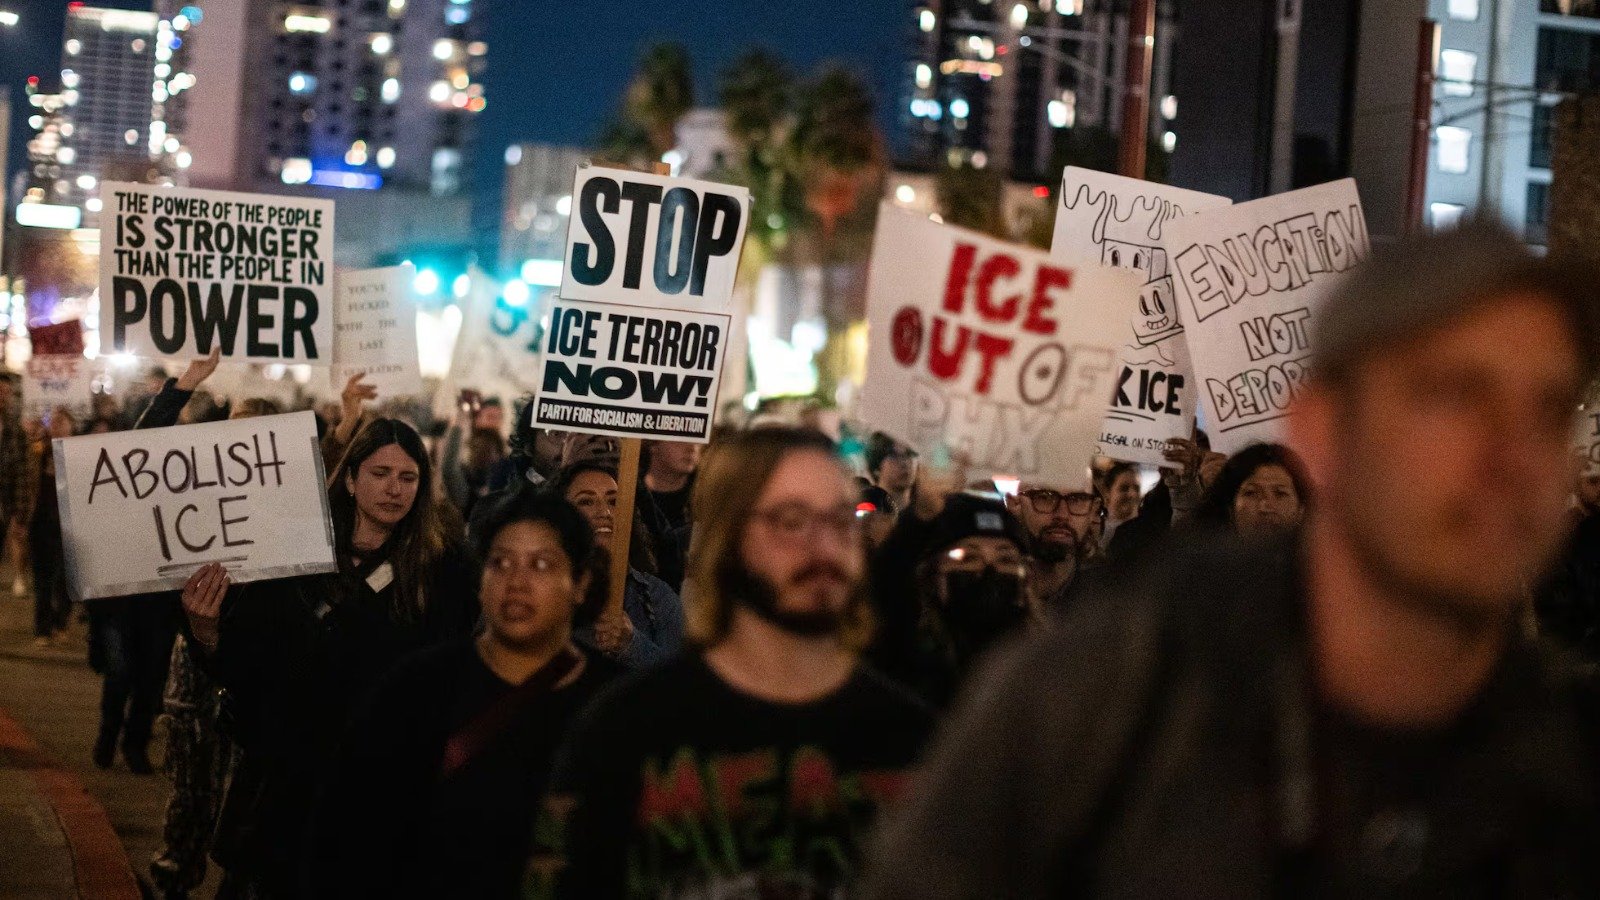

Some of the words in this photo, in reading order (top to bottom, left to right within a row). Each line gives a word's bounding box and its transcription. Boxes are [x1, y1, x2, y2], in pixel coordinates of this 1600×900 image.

[115, 192, 148, 214] THE
[153, 195, 209, 218] POWER
[212, 202, 232, 220] OF
[235, 203, 263, 223] THE
[268, 209, 322, 228] PEOPLE
[116, 214, 145, 248] IS
[154, 216, 318, 260] STRONGER
[571, 176, 742, 297] STOP
[114, 249, 169, 277] THAN
[175, 252, 214, 279] THE
[220, 256, 292, 283] PEOPLE
[301, 261, 324, 285] IN
[943, 241, 1073, 335] ICE
[113, 275, 319, 359] POWER
[548, 307, 602, 359] ICE
[607, 313, 720, 371] TERROR
[1240, 307, 1312, 361] NOT
[542, 359, 714, 408] NOW!
[891, 305, 1014, 395] OUT
[1018, 342, 1114, 411] OF
[540, 403, 572, 421] PARTY
[573, 406, 593, 424] FOR
[593, 409, 644, 429] SOCIALISM
[643, 415, 656, 430] &
[656, 415, 704, 434] LIBERATION
[1138, 369, 1184, 416] ICE
[88, 430, 286, 504] ABOLISH
[1132, 438, 1143, 448] ON
[152, 494, 255, 562] ICE
